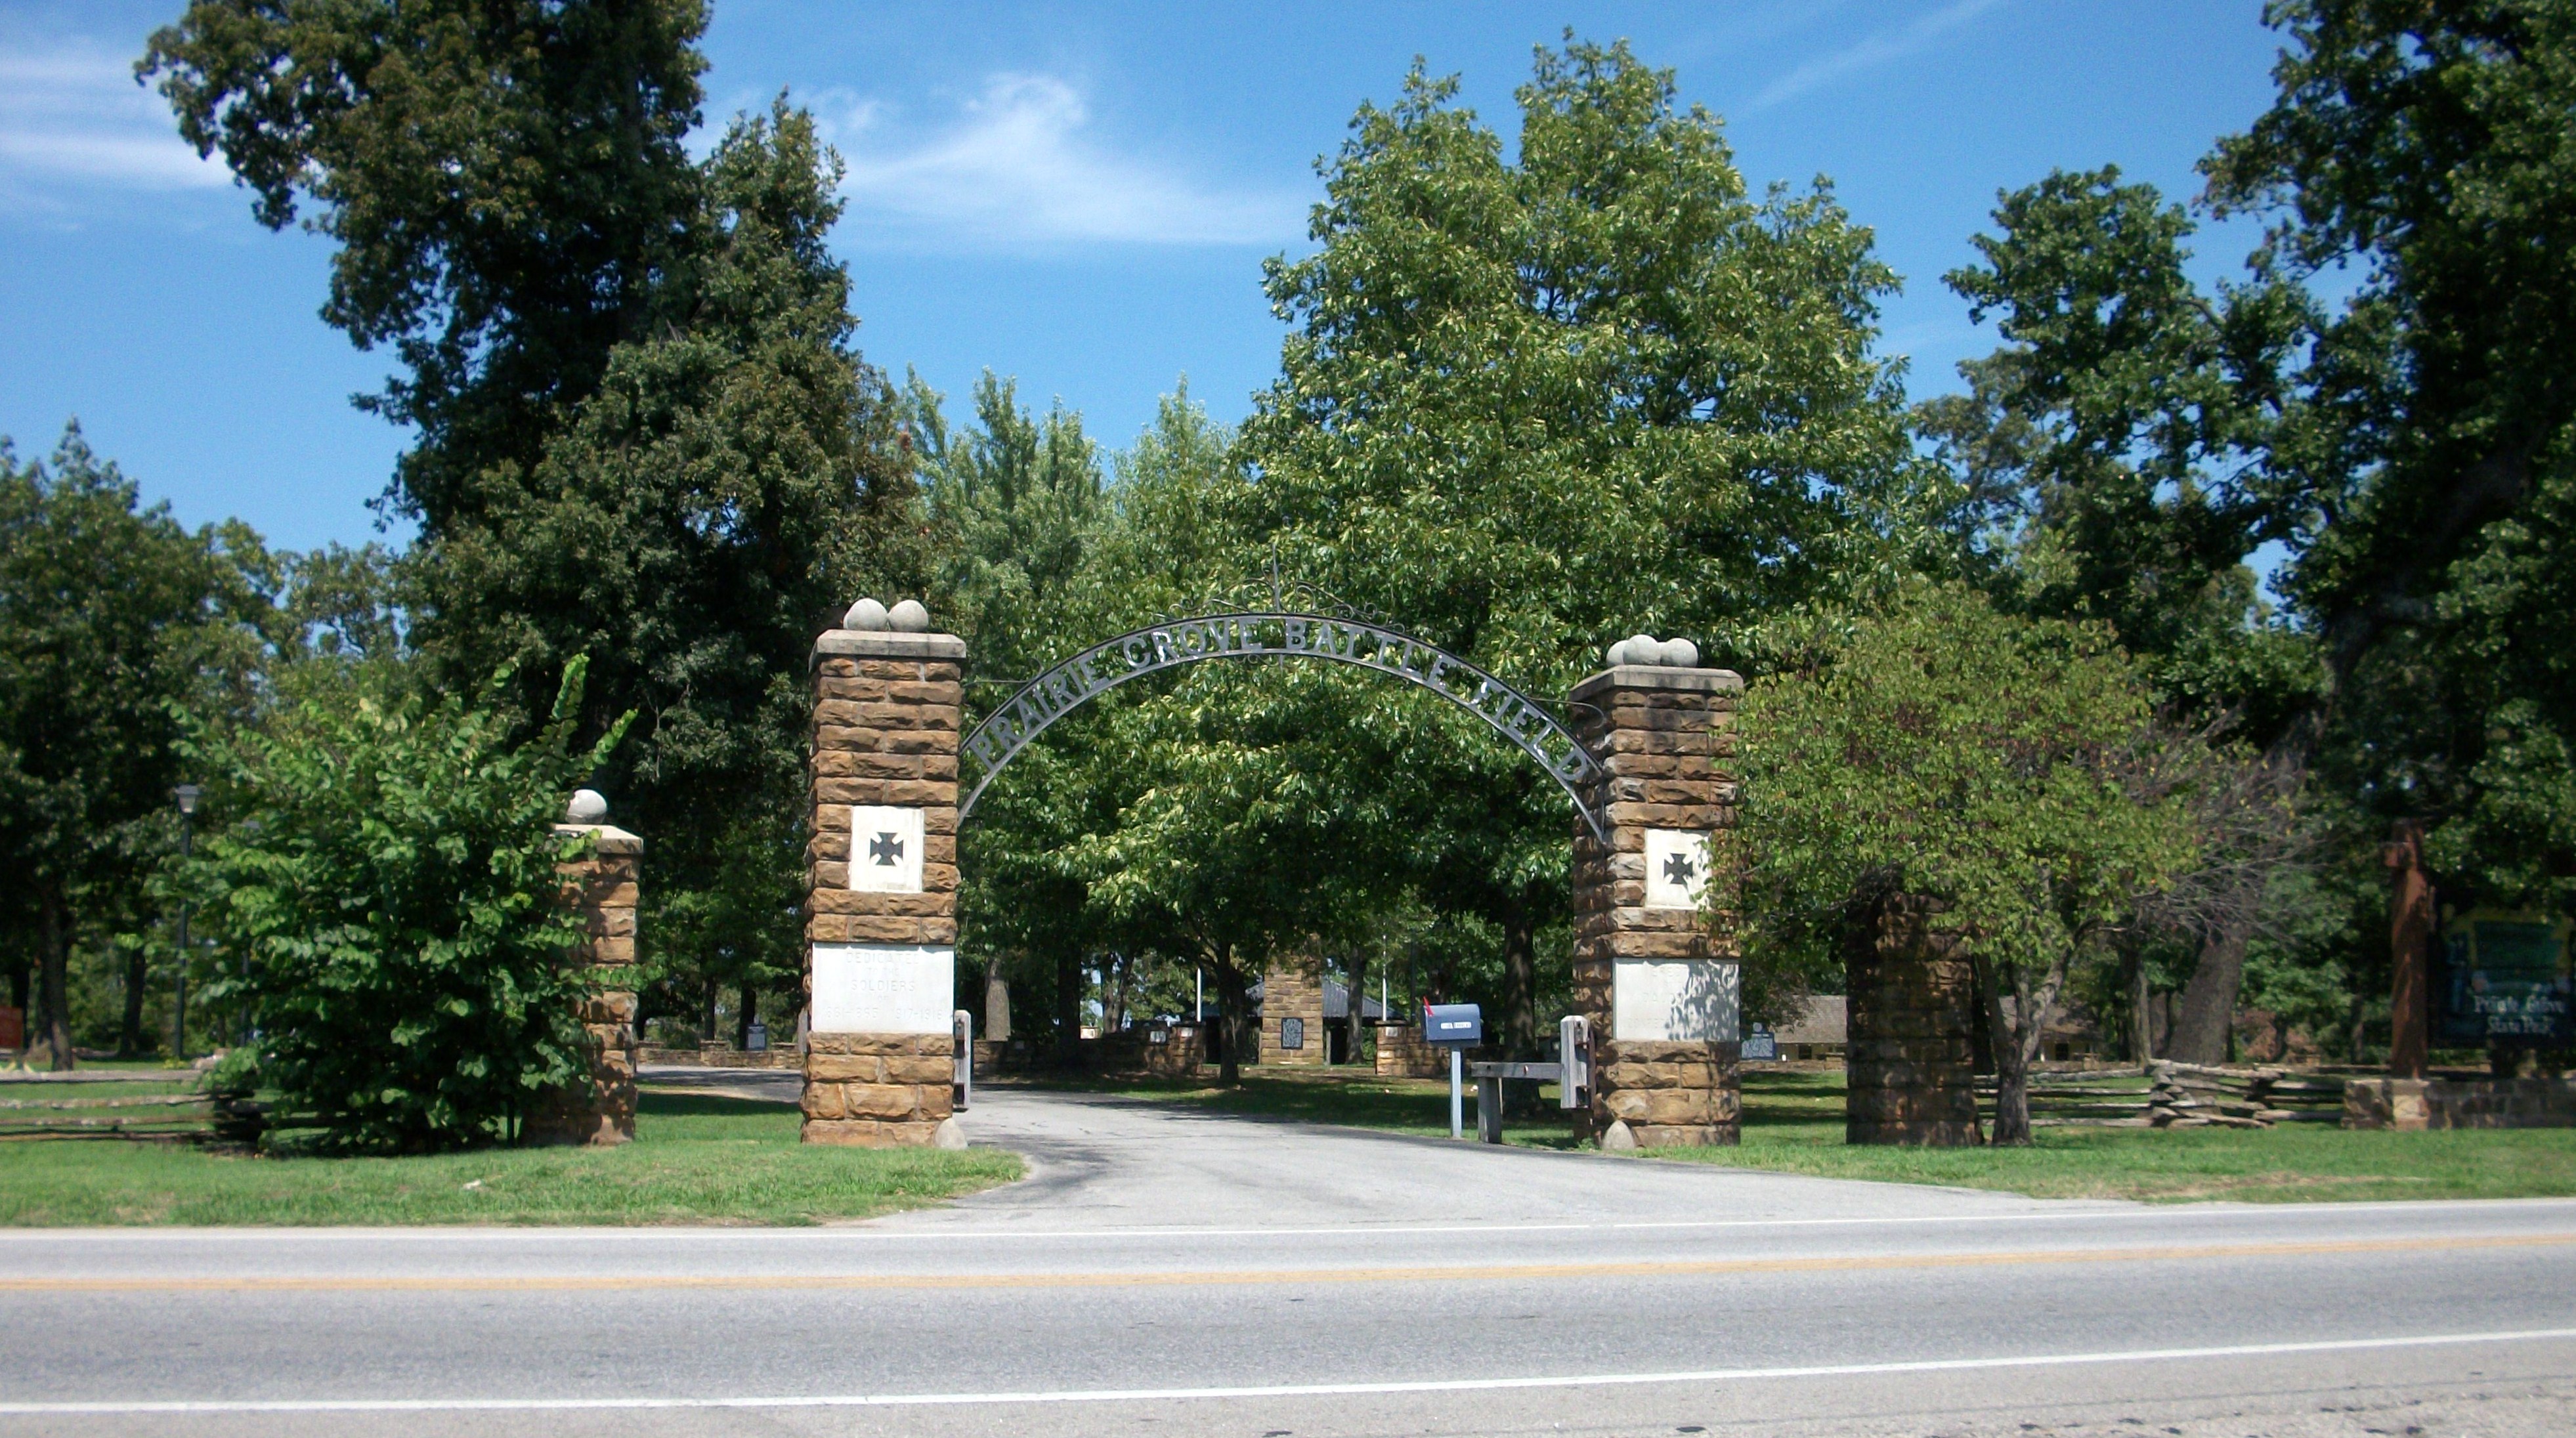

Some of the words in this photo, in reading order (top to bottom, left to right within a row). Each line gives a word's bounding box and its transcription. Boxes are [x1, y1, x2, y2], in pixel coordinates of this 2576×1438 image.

[969, 650, 1109, 772] PRAIRIE
[1123, 618, 1262, 669] GROVE
[846, 951, 920, 965] DEDICATED
[850, 979, 916, 992] SOLDIERS
